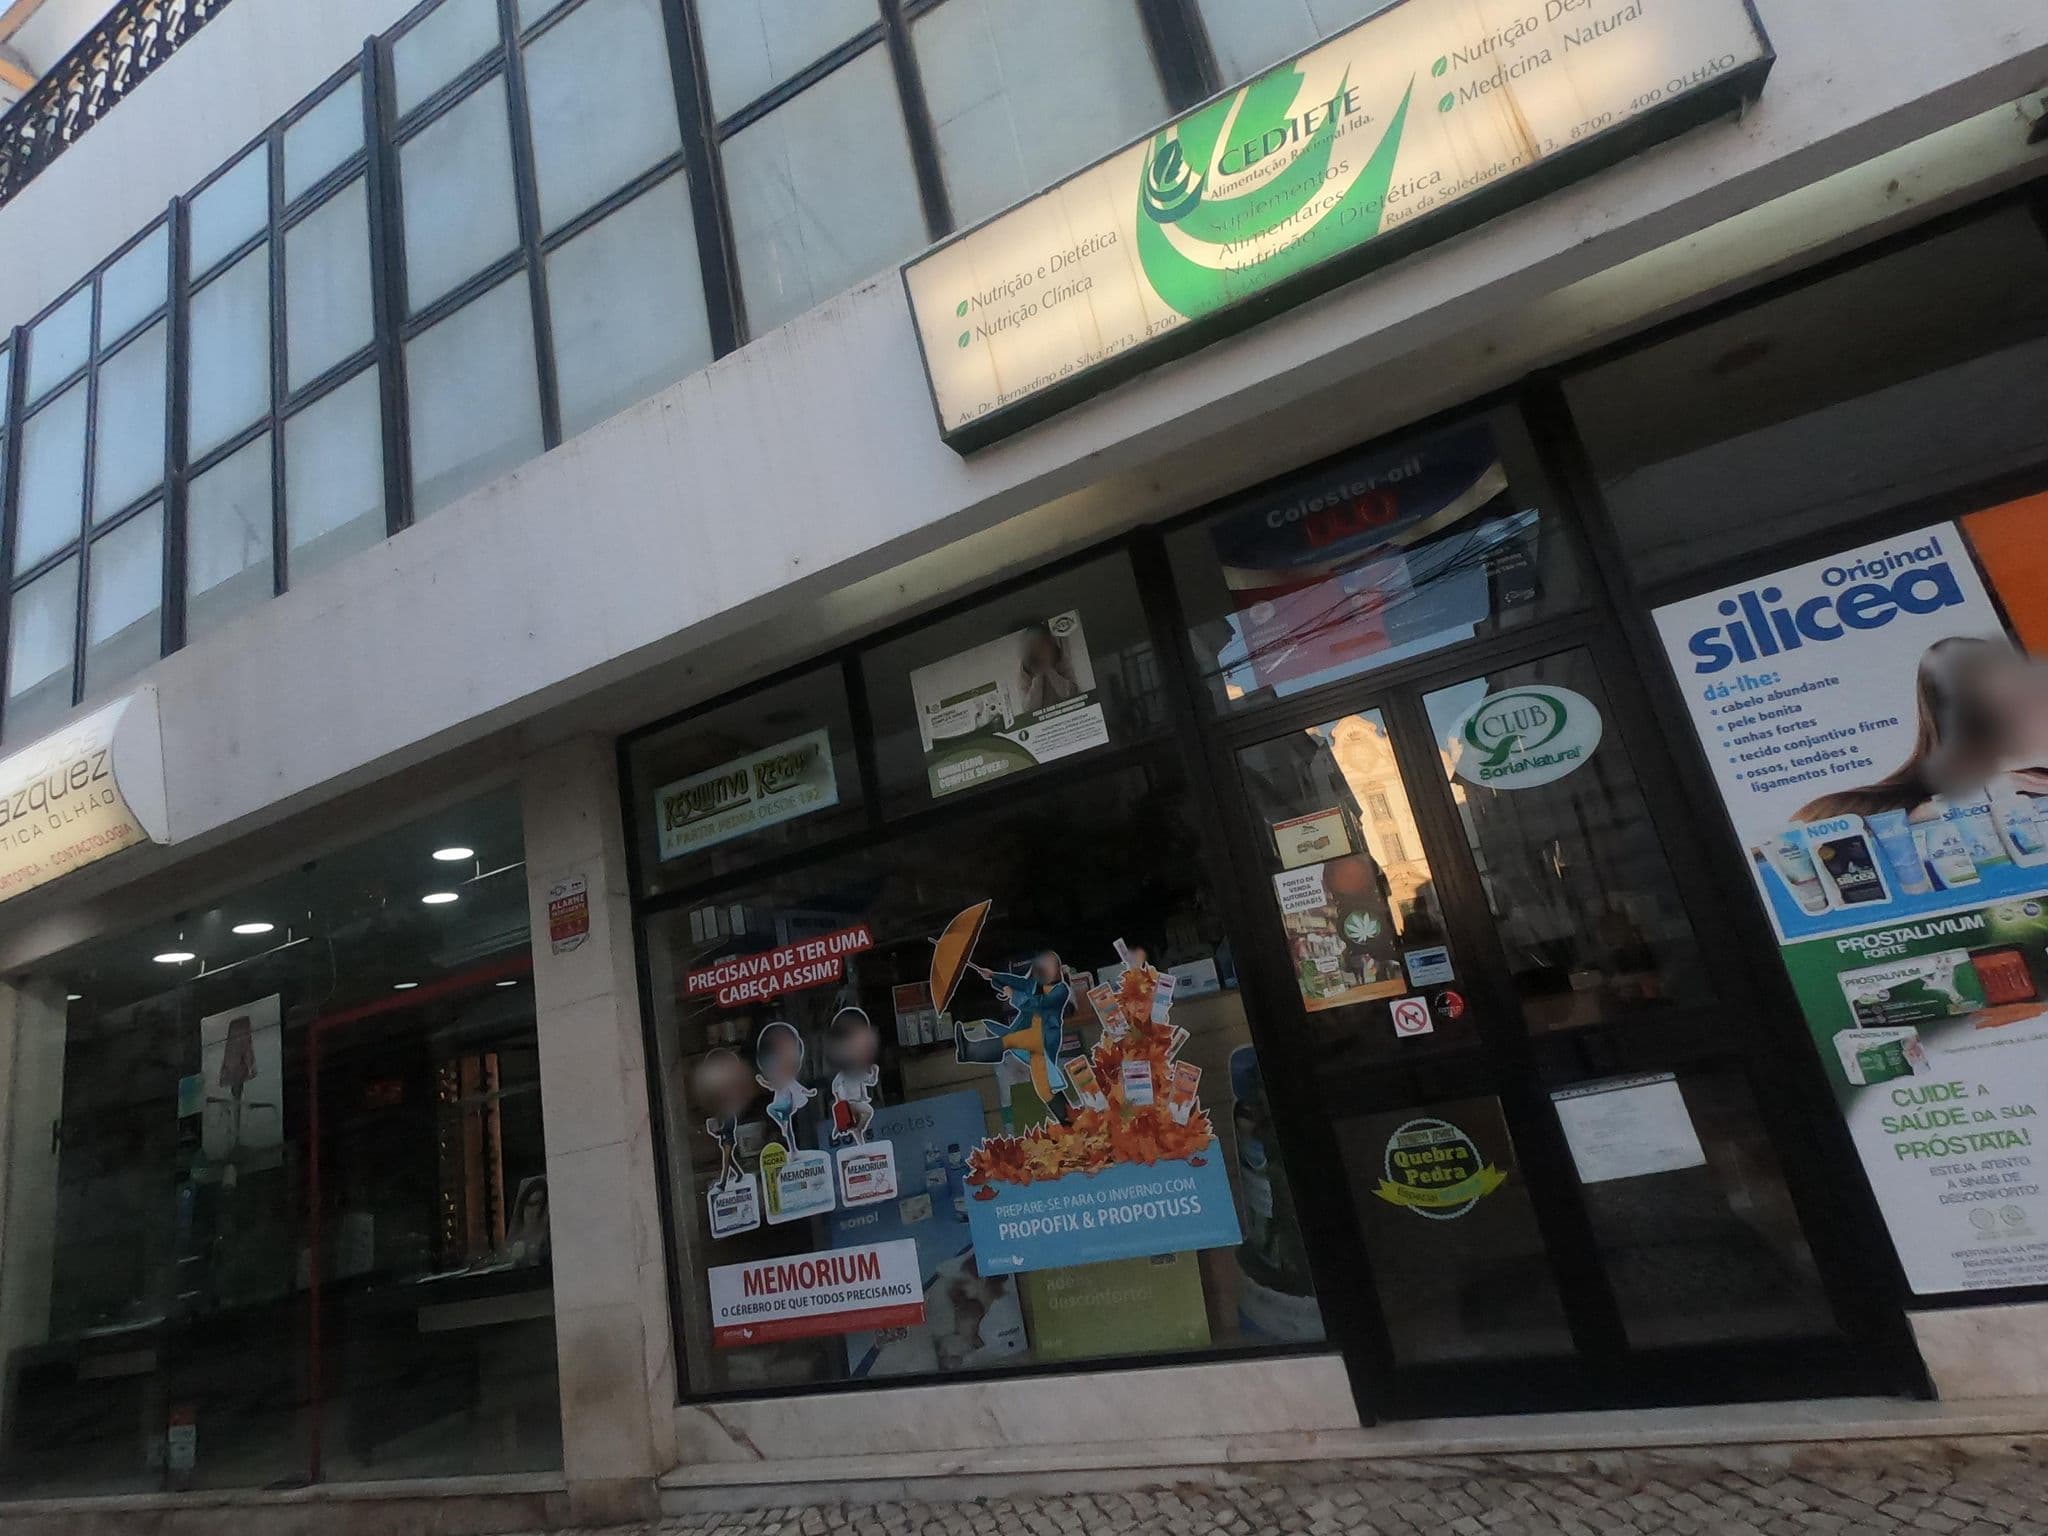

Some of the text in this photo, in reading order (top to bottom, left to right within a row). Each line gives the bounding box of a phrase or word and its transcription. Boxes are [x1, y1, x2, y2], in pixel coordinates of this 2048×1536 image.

[1451, 16, 1539, 70] Nutrição
[1458, 0, 1643, 105] Medicina Natural
[1217, 86, 1361, 176] CEDIETE
[1387, 208, 1413, 225] Rua
[1417, 195, 1434, 211] da
[1438, 160, 1508, 199] Soledade
[1569, 111, 1613, 138] 8700
[1665, 53, 1737, 93] OLHÃO
[1209, 160, 1349, 233] Suplementos
[1211, 155, 1286, 200] Alimentação
[1218, 191, 1344, 259] Alimentares
[1225, 169, 1442, 279] Nutrição Dietética
[970, 229, 1118, 311] Nutrição e Dietética
[975, 273, 1094, 342] Nutrição Clínica
[959, 408, 975, 423] Av.
[978, 398, 995, 414] Dr.
[996, 370, 1057, 406] Bernardino
[1059, 360, 1074, 378] da
[1077, 348, 1103, 369] Silva
[1145, 314, 1177, 338] 8700
[1821, 536, 1943, 587] Original
[1688, 561, 1965, 674] silicea
[1703, 672, 1781, 702] dá-lhe:
[1721, 675, 1840, 714] cabelo abundante
[1482, 704, 1548, 738] CLUB
[1727, 703, 1803, 732] pele bonita
[1733, 718, 1818, 746] unhas fortes
[1740, 716, 1899, 762] tecido conjuntivo firme
[1480, 747, 1583, 780] SoriaNatural
[1746, 745, 1859, 779] ossos, tendões e
[1751, 756, 1873, 793] ligamentos fortes
[49, 788, 116, 830] OLHÃO
[1806, 819, 1849, 838] NOVO
[51, 823, 133, 865] CONTACTOLOGIA
[1836, 914, 1986, 954] PROSTALIVIUM
[1862, 943, 1908, 960] FORTE
[688, 929, 870, 992] PRECISAVA DE TER UMA
[719, 959, 840, 1005] CABEÇA ASSIM?
[1891, 1081, 1990, 1107] CUIDE A
[1881, 1104, 2037, 1135] SAÚDE DA SUA
[1393, 1146, 1469, 1168] Quebra
[1894, 1127, 2032, 1161] PRÓSTATA!
[779, 1165, 825, 1182] MEMORIUM
[846, 1160, 889, 1175] MEMORIUM
[1405, 1166, 1468, 1186] Pedra
[1930, 1162, 1977, 1177] ESTEJA
[2001, 1171, 2020, 1183] DE
[996, 1177, 1197, 1218] PREPARE-SE PARA O INVERNO COM
[999, 1195, 1202, 1241] PROPOFIX & PROPOTUSS
[743, 1251, 881, 1298] MEMORIUM
[721, 1283, 913, 1318] O CÉREBRO DE QUE TODOS PRECISAMOS
